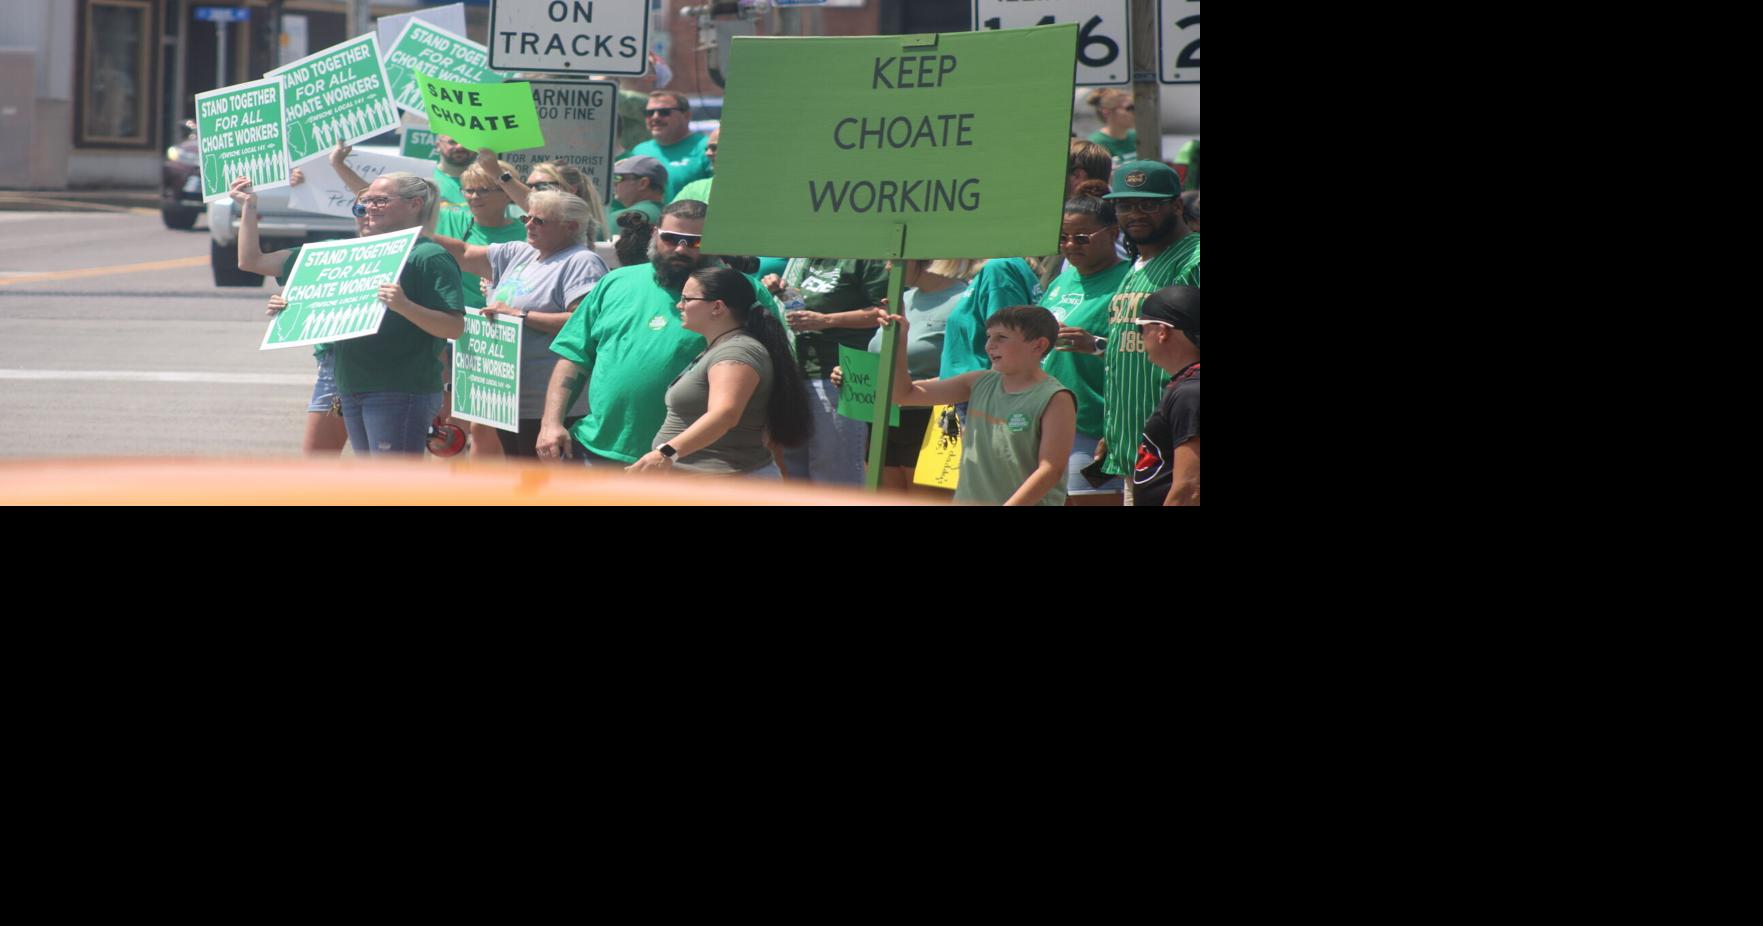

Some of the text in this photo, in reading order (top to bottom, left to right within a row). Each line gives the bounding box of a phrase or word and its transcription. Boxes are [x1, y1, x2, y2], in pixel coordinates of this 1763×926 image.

[548, 0, 593, 23] ON
[411, 28, 489, 70] STAND TOGET
[500, 32, 637, 58] TRACKS
[311, 45, 370, 77] TOGETHER
[391, 51, 440, 78] CHOATE
[419, 49, 454, 68] FOR
[453, 64, 482, 82] ALL
[872, 54, 958, 90] KEEP
[287, 74, 379, 120] HOATE WORKERS
[296, 68, 356, 100] FOR ALL
[427, 84, 482, 106] SAVE
[201, 88, 276, 118] STAND TOGETHER
[532, 88, 604, 108] ARNING
[215, 110, 263, 131] FOR ALL
[431, 104, 519, 131] CHOATE
[536, 106, 596, 121] 00 FINE
[202, 122, 279, 153] CHOATE WORKERS
[410, 131, 439, 145] STA
[833, 113, 976, 151] CHOATE
[506, 153, 526, 163] FOR
[808, 178, 981, 214] WORKING
[305, 239, 407, 267] STAND TOGETHER
[317, 261, 380, 282] FOR ALL
[288, 283, 336, 301] CHOATE
[464, 316, 516, 344] TAND TOGETHER
[468, 338, 504, 358] FOR ALL
[455, 351, 515, 380] CHOATE WORKERS
